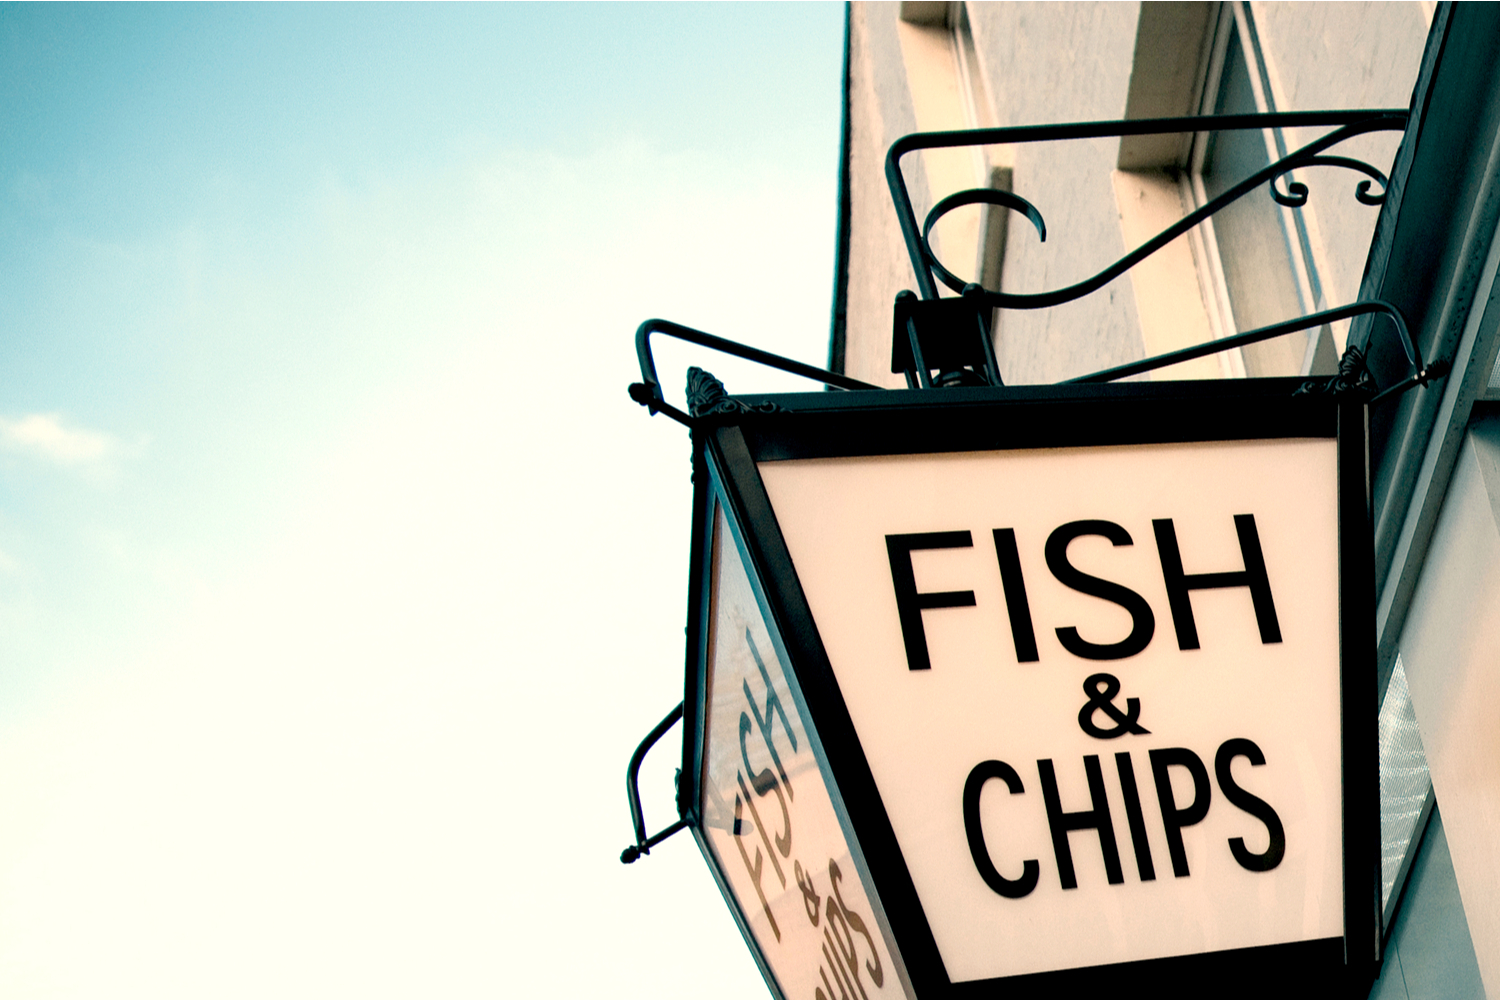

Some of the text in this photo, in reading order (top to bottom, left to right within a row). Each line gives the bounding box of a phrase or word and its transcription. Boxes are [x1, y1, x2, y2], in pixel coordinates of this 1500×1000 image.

[884, 513, 1284, 671] FISH
[733, 624, 798, 944] FISH
[1077, 672, 1152, 739] &
[793, 858, 821, 928] &
[962, 737, 1286, 899] CHIPS
